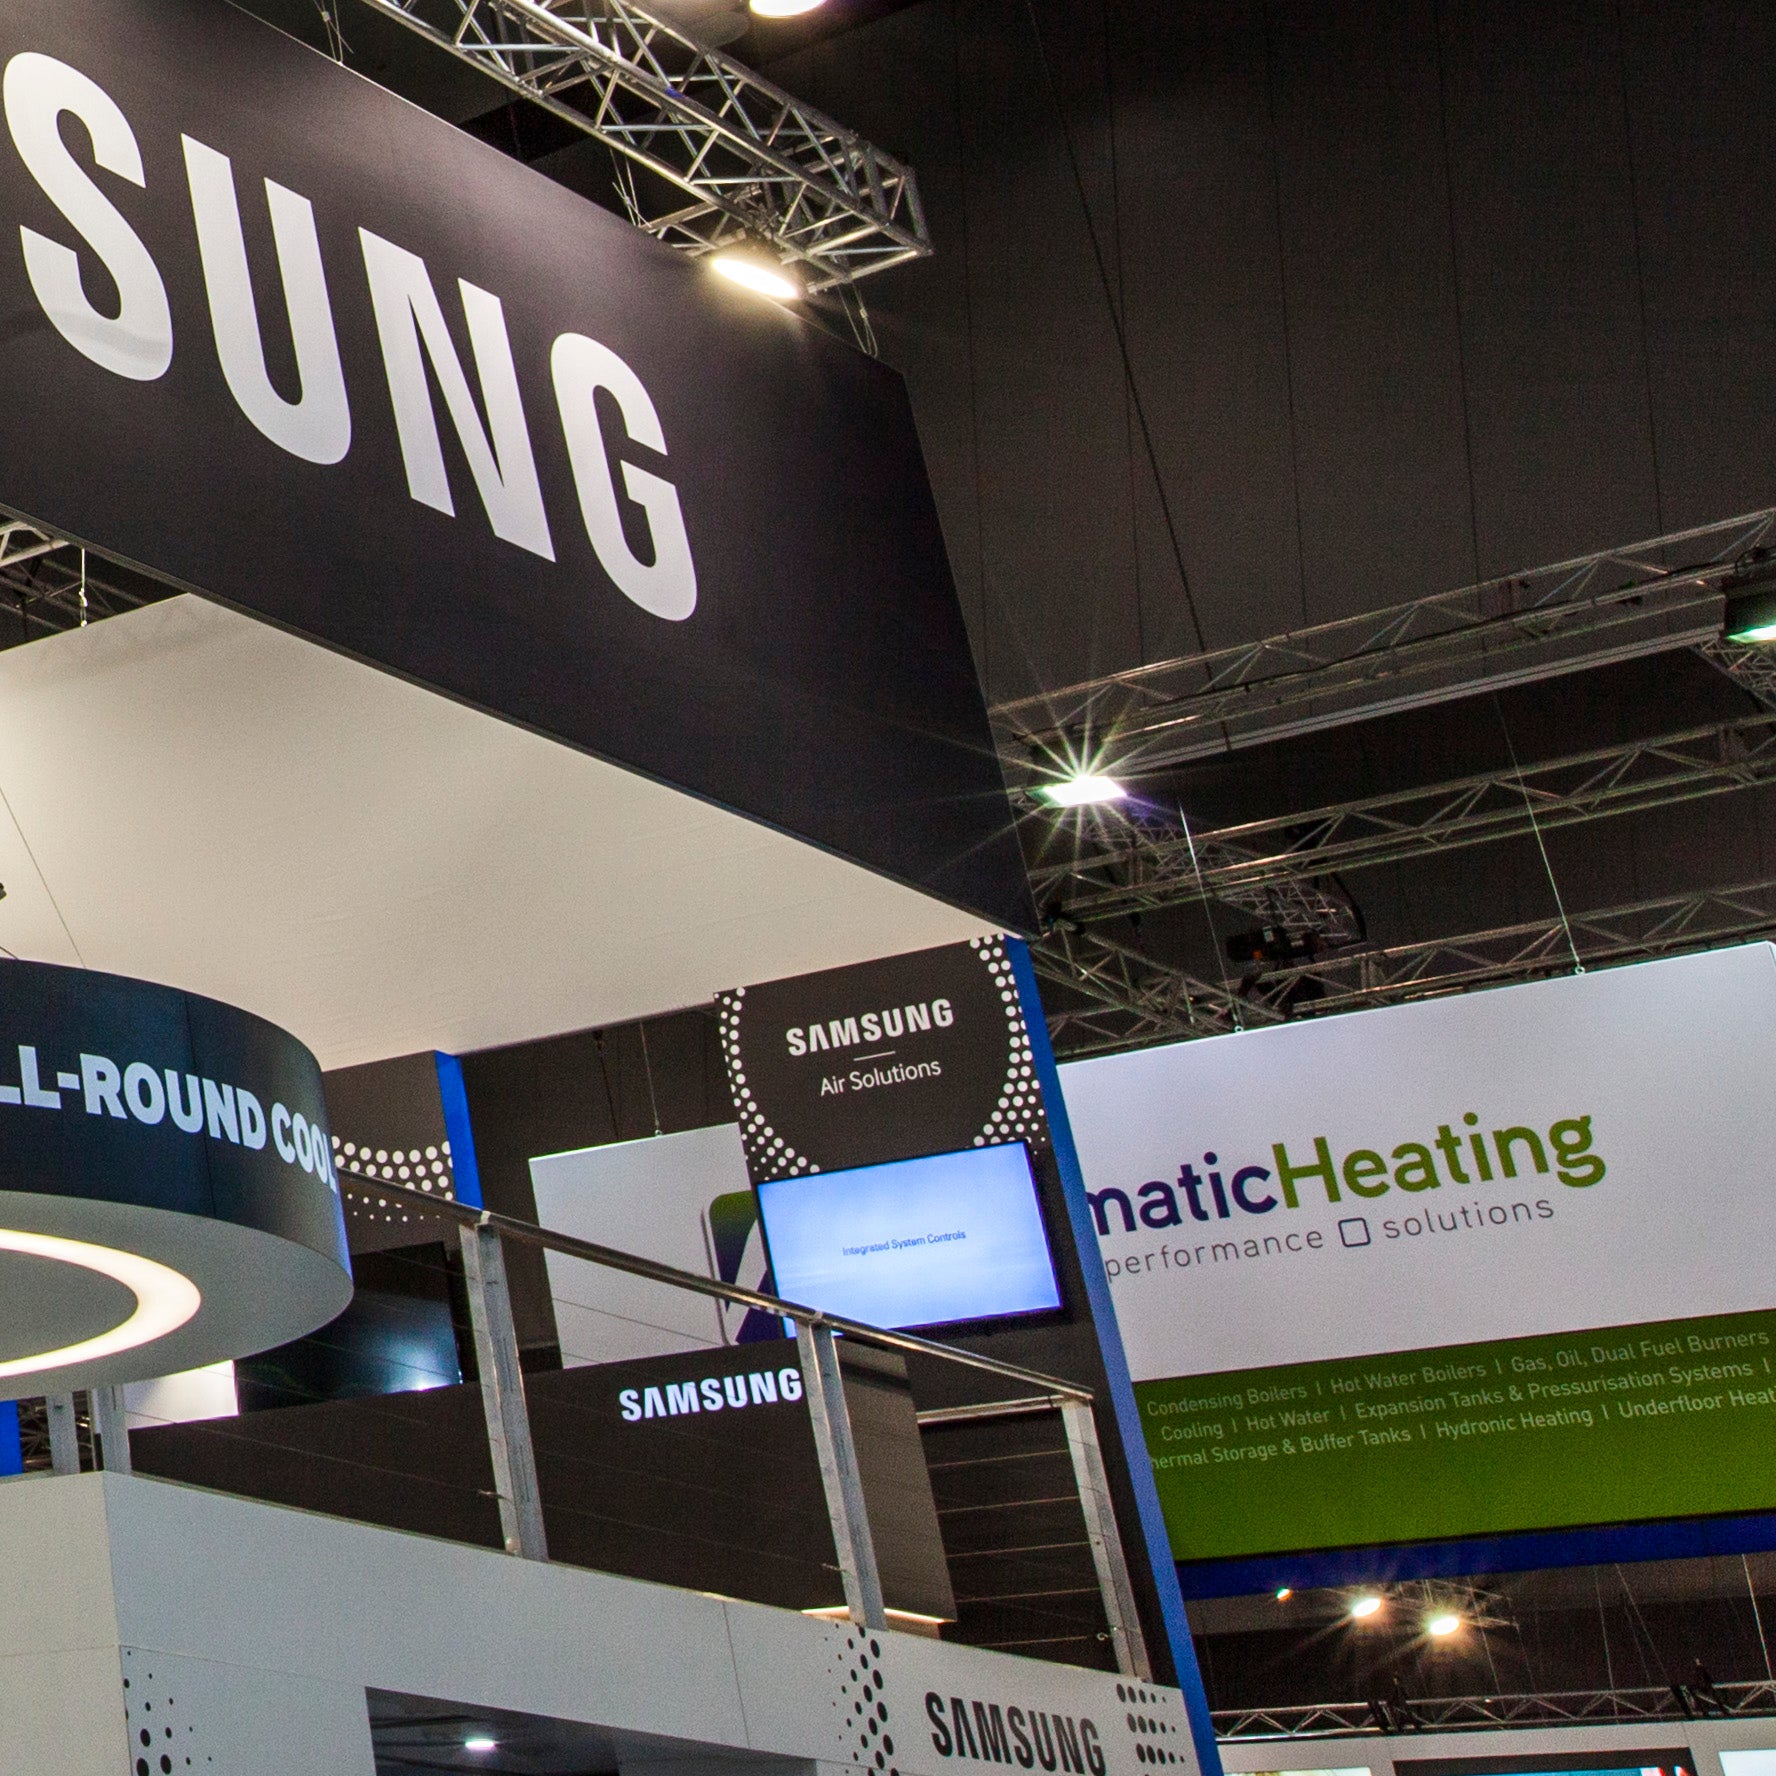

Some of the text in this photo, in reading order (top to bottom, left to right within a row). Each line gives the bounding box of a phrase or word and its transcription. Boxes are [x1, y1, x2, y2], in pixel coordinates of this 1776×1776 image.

[786, 997, 954, 1057] SAMSUNG
[820, 1057, 942, 1097] Air Solutions
[842, 1230, 966, 1256] Integrated System Controls
[1105, 1196, 1555, 1282] performance solutions
[619, 1366, 804, 1422] SAMSUNG
[1147, 1330, 1770, 1417] Condensing Boilers Hot Water Boilers Gas, Oil, Dual Fuel Burners
[1161, 1361, 1753, 1441] Cooling Hot Water Expansion Tanks & Pressurisation Systems
[1212, 1442, 1278, 1463] Storage
[1282, 1438, 1297, 1455] &
[1302, 1433, 1354, 1453] Buffer
[1358, 1426, 1411, 1446] Tanks
[1435, 1414, 1515, 1441] Hydronic
[1520, 1406, 1594, 1429] Heating
[1618, 1394, 1723, 1419] Underfloor
[925, 1691, 1107, 1776] SAMSUNG
